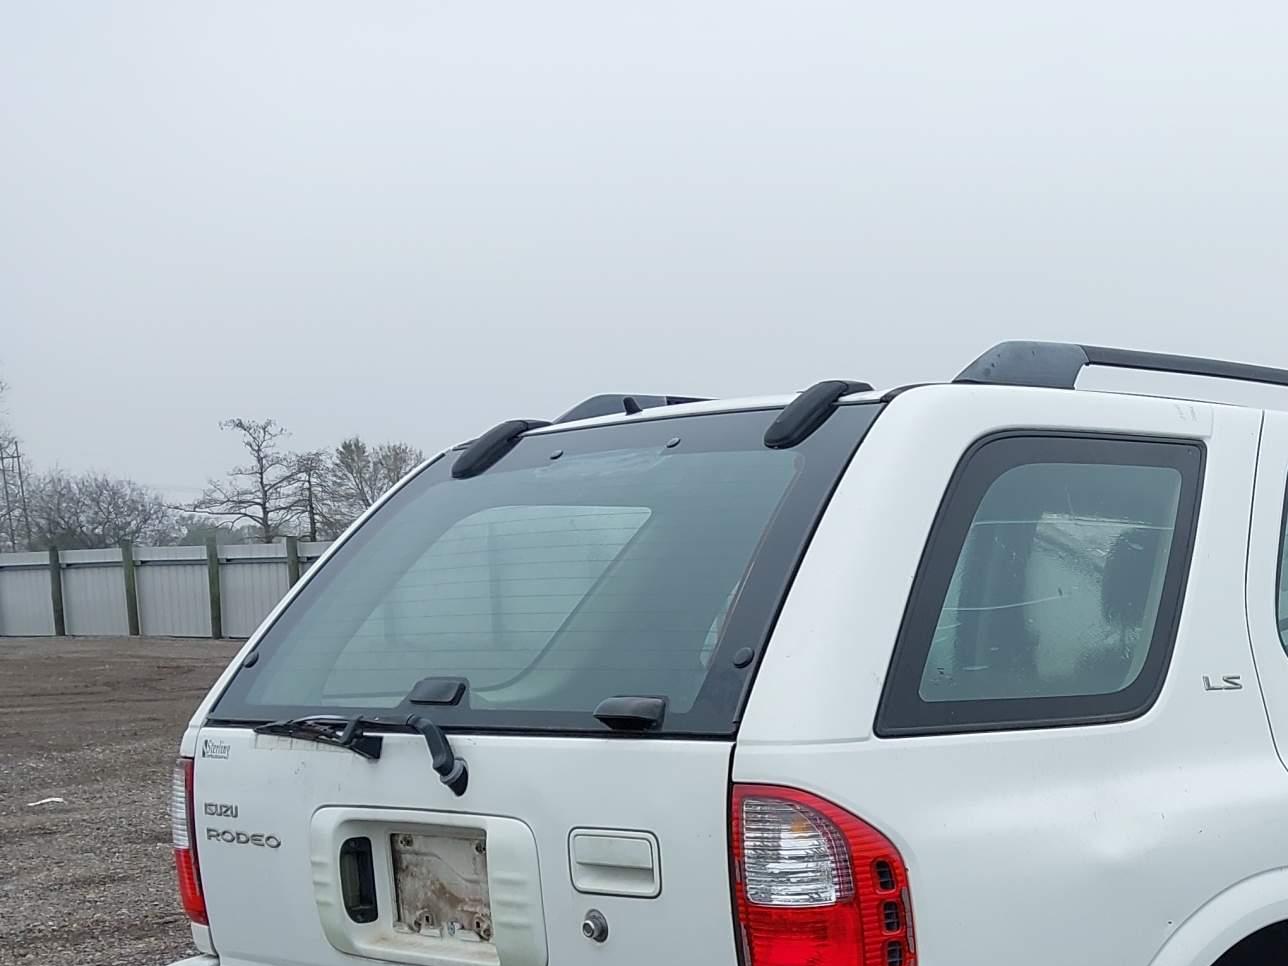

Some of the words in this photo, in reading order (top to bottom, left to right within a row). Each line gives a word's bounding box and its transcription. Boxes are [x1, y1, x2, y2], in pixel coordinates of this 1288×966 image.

[1203, 675, 1243, 691] LS
[204, 803, 239, 818] ISUZU
[206, 827, 282, 849] RODEO
